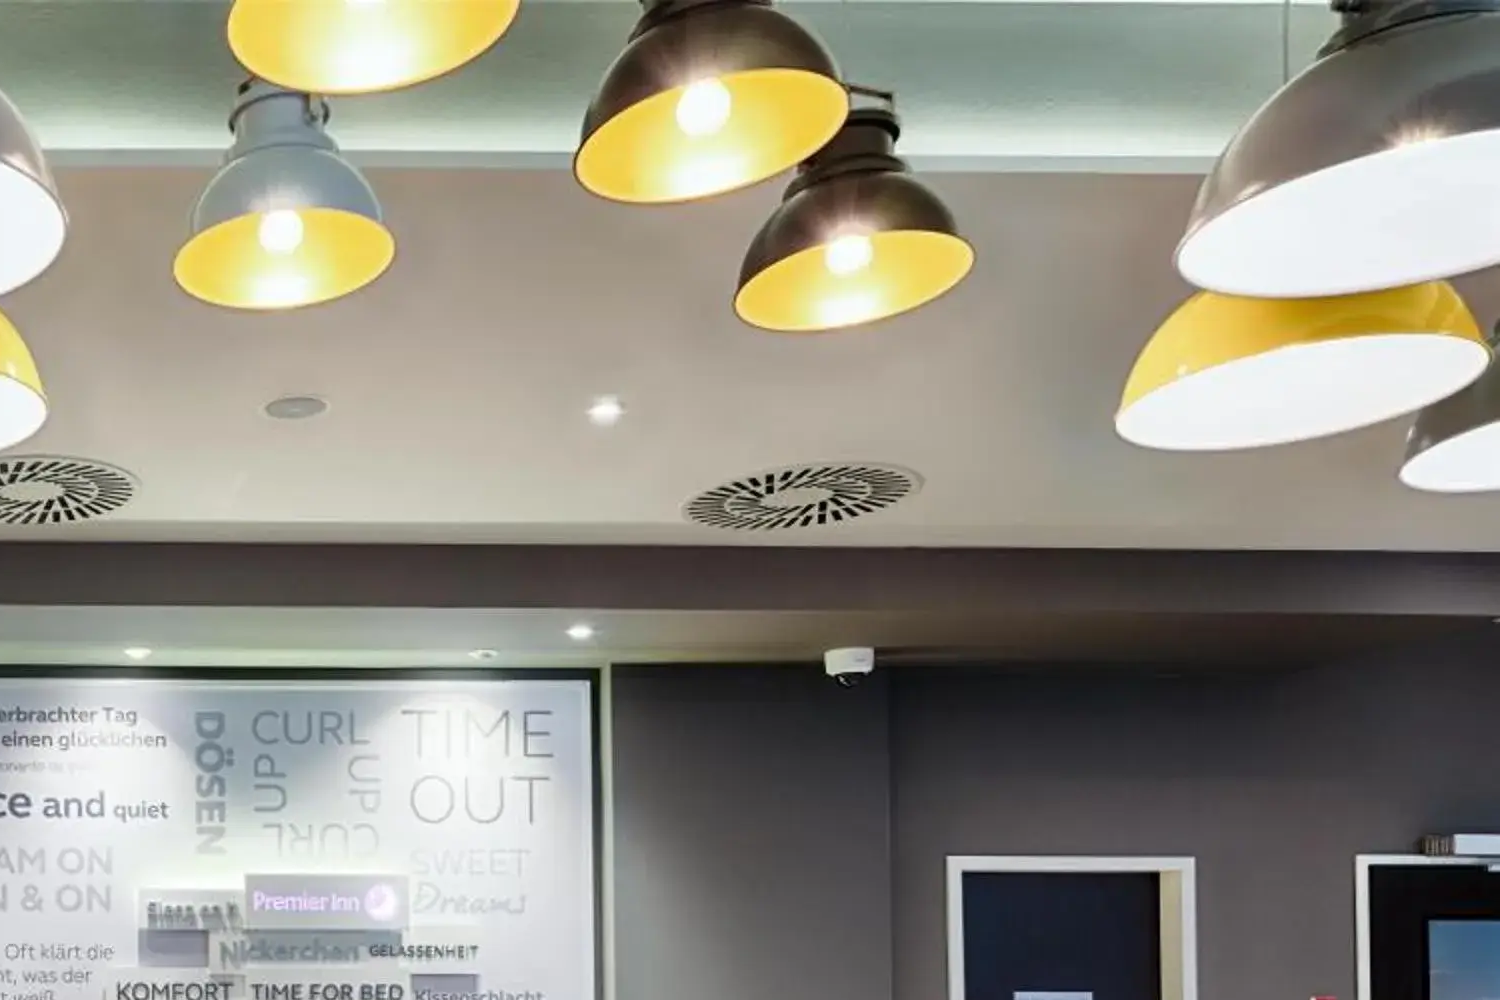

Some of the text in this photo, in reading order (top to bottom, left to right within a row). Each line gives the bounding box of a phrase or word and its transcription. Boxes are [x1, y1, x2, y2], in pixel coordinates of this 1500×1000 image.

[102, 708, 137, 727] Tag
[251, 709, 371, 745] CURL
[1, 732, 53, 748] einen
[58, 730, 167, 751] glücklichen
[400, 708, 555, 758] TIME
[195, 711, 235, 855] DÖSEN
[252, 753, 287, 813] UP
[348, 754, 381, 814] UP
[43, 790, 106, 818] and
[113, 801, 170, 823] quiet
[409, 775, 552, 826] OUT
[56, 846, 113, 875] ON
[409, 848, 531, 876] SWEET
[20, 885, 43, 912] &
[55, 885, 111, 912] ON
[252, 890, 359, 913] Premier Inn
[5, 943, 114, 960] Oft klärt die
[220, 937, 361, 964] Nickerchen
[369, 944, 478, 959] GELASSENHEIT
[23, 969, 57, 984] was
[62, 966, 92, 984] der
